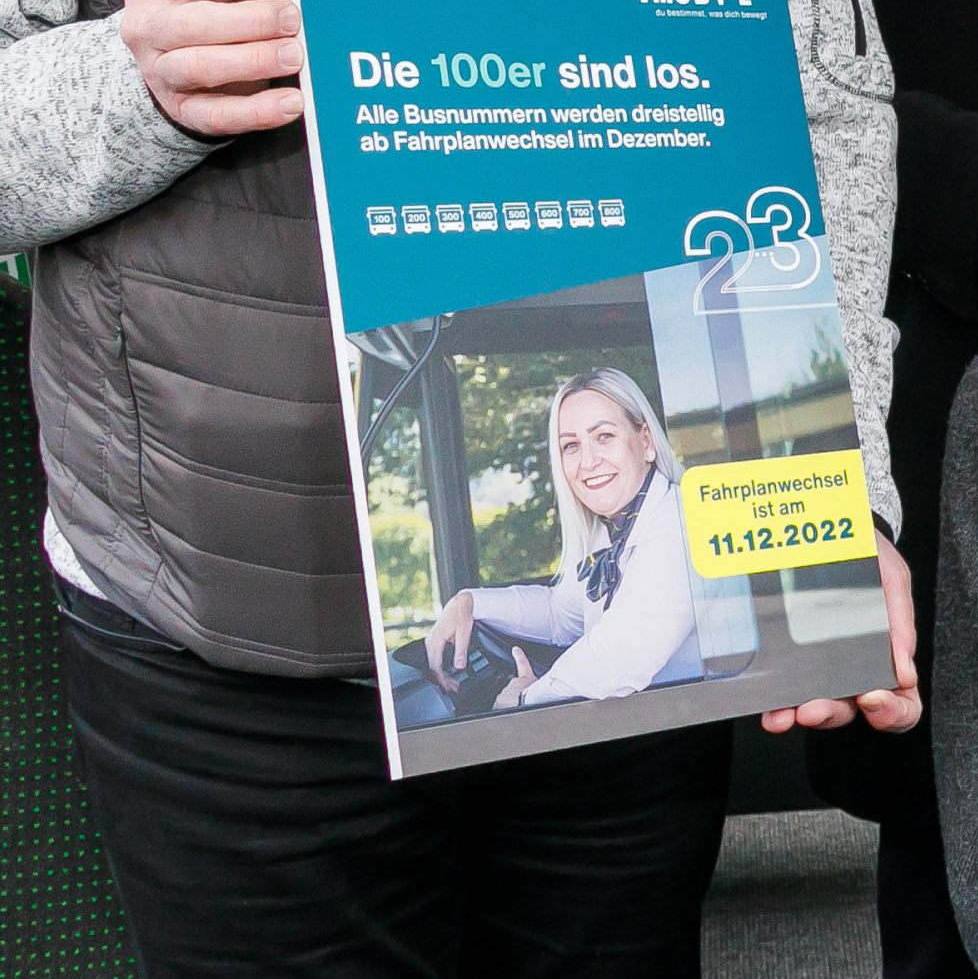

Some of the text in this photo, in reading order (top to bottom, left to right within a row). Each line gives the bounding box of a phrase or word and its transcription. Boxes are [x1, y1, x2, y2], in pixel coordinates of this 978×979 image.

[655, 9, 666, 17] du
[724, 10, 740, 18] dich
[350, 51, 710, 89] Die 100er sind los.
[356, 104, 725, 126] Alle Busnummern werden dreistellig
[360, 128, 711, 155] ab Fahrplanwechsel im Dezember.
[374, 214, 390, 223] 100
[408, 213, 426, 222] 200
[442, 212, 459, 221] 300
[475, 211, 493, 220] 400
[508, 210, 526, 218] 500
[541, 209, 558, 218] 600
[573, 208, 590, 217] 700
[684, 186, 821, 314] 23
[699, 470, 849, 502] Fahrplanwechsel
[752, 500, 805, 519] ist am
[709, 517, 855, 556] 11.12.2022
